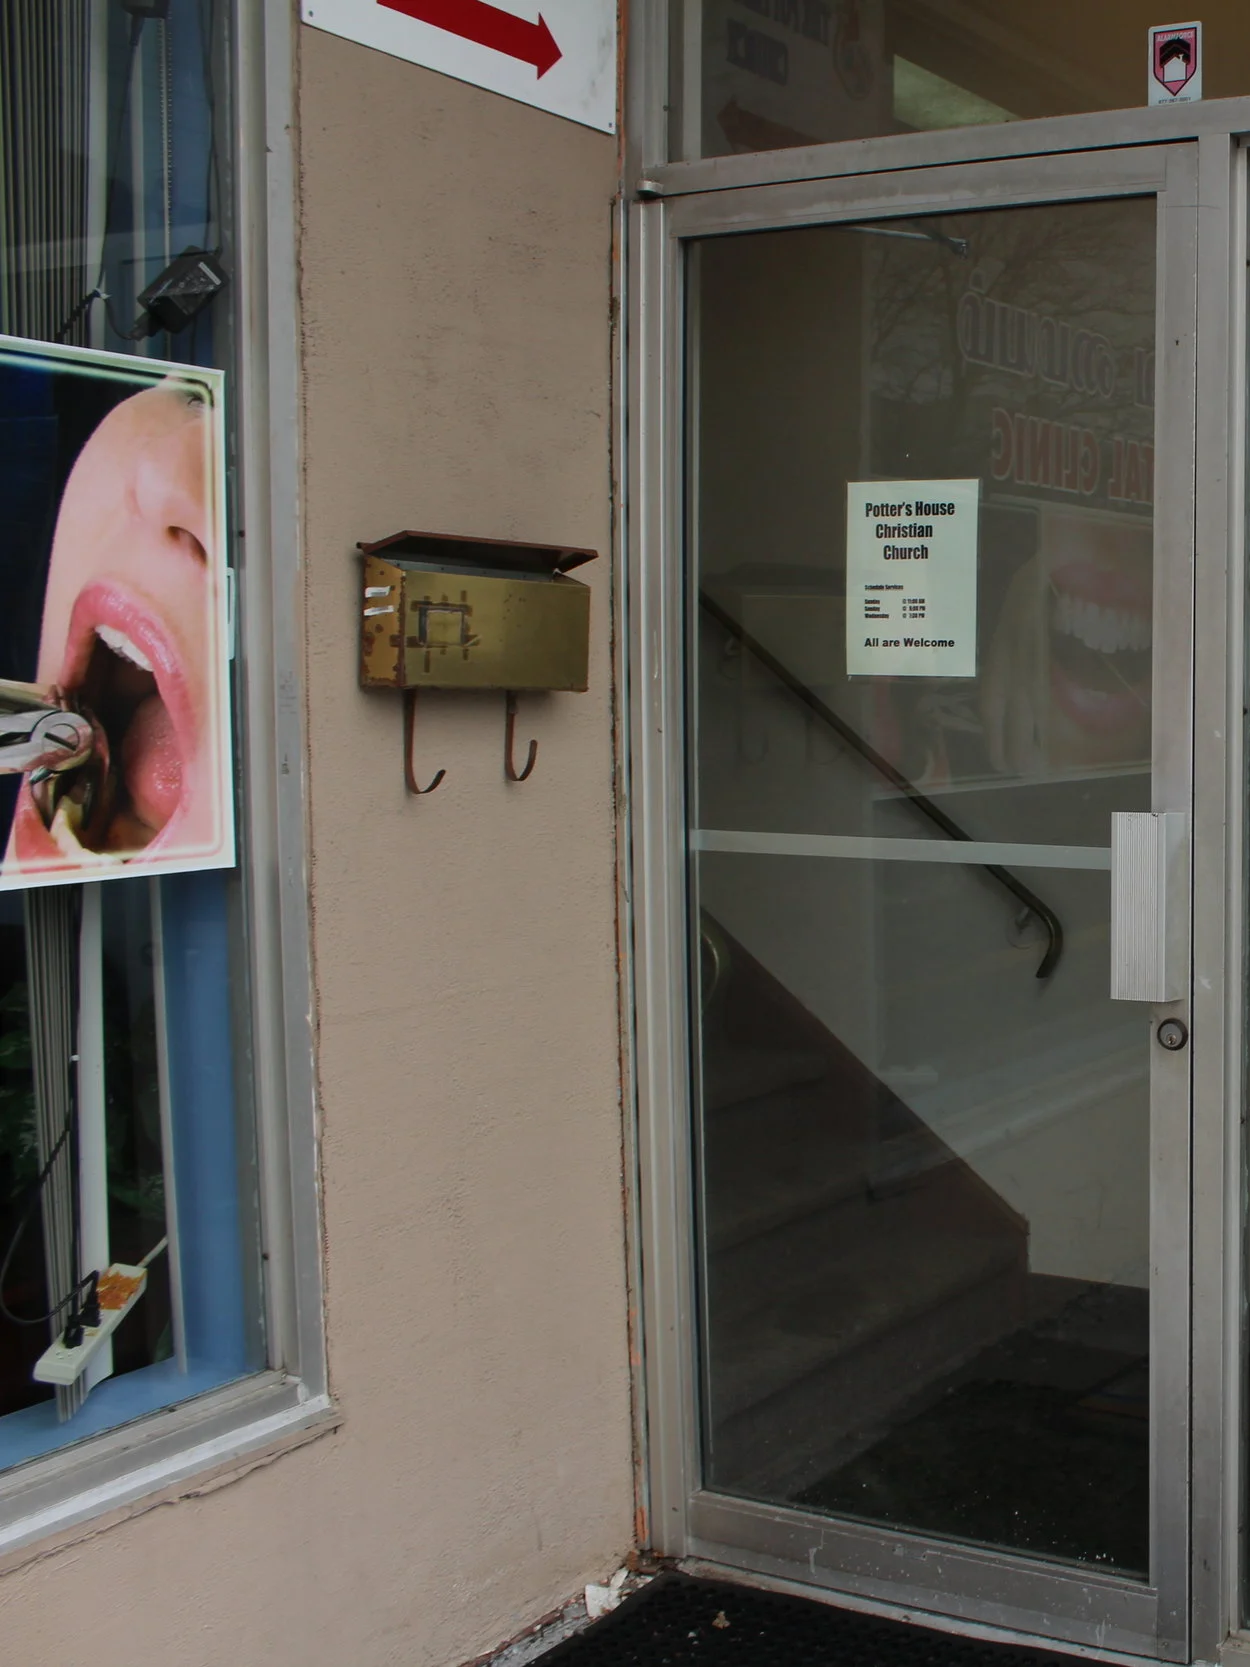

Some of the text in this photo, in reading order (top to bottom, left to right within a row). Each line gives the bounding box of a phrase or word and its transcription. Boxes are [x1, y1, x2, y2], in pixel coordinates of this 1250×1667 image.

[865, 501, 955, 517] Potter's House
[875, 523, 933, 538] Christian
[883, 545, 929, 560] Church
[864, 637, 955, 647] All are Welcome
